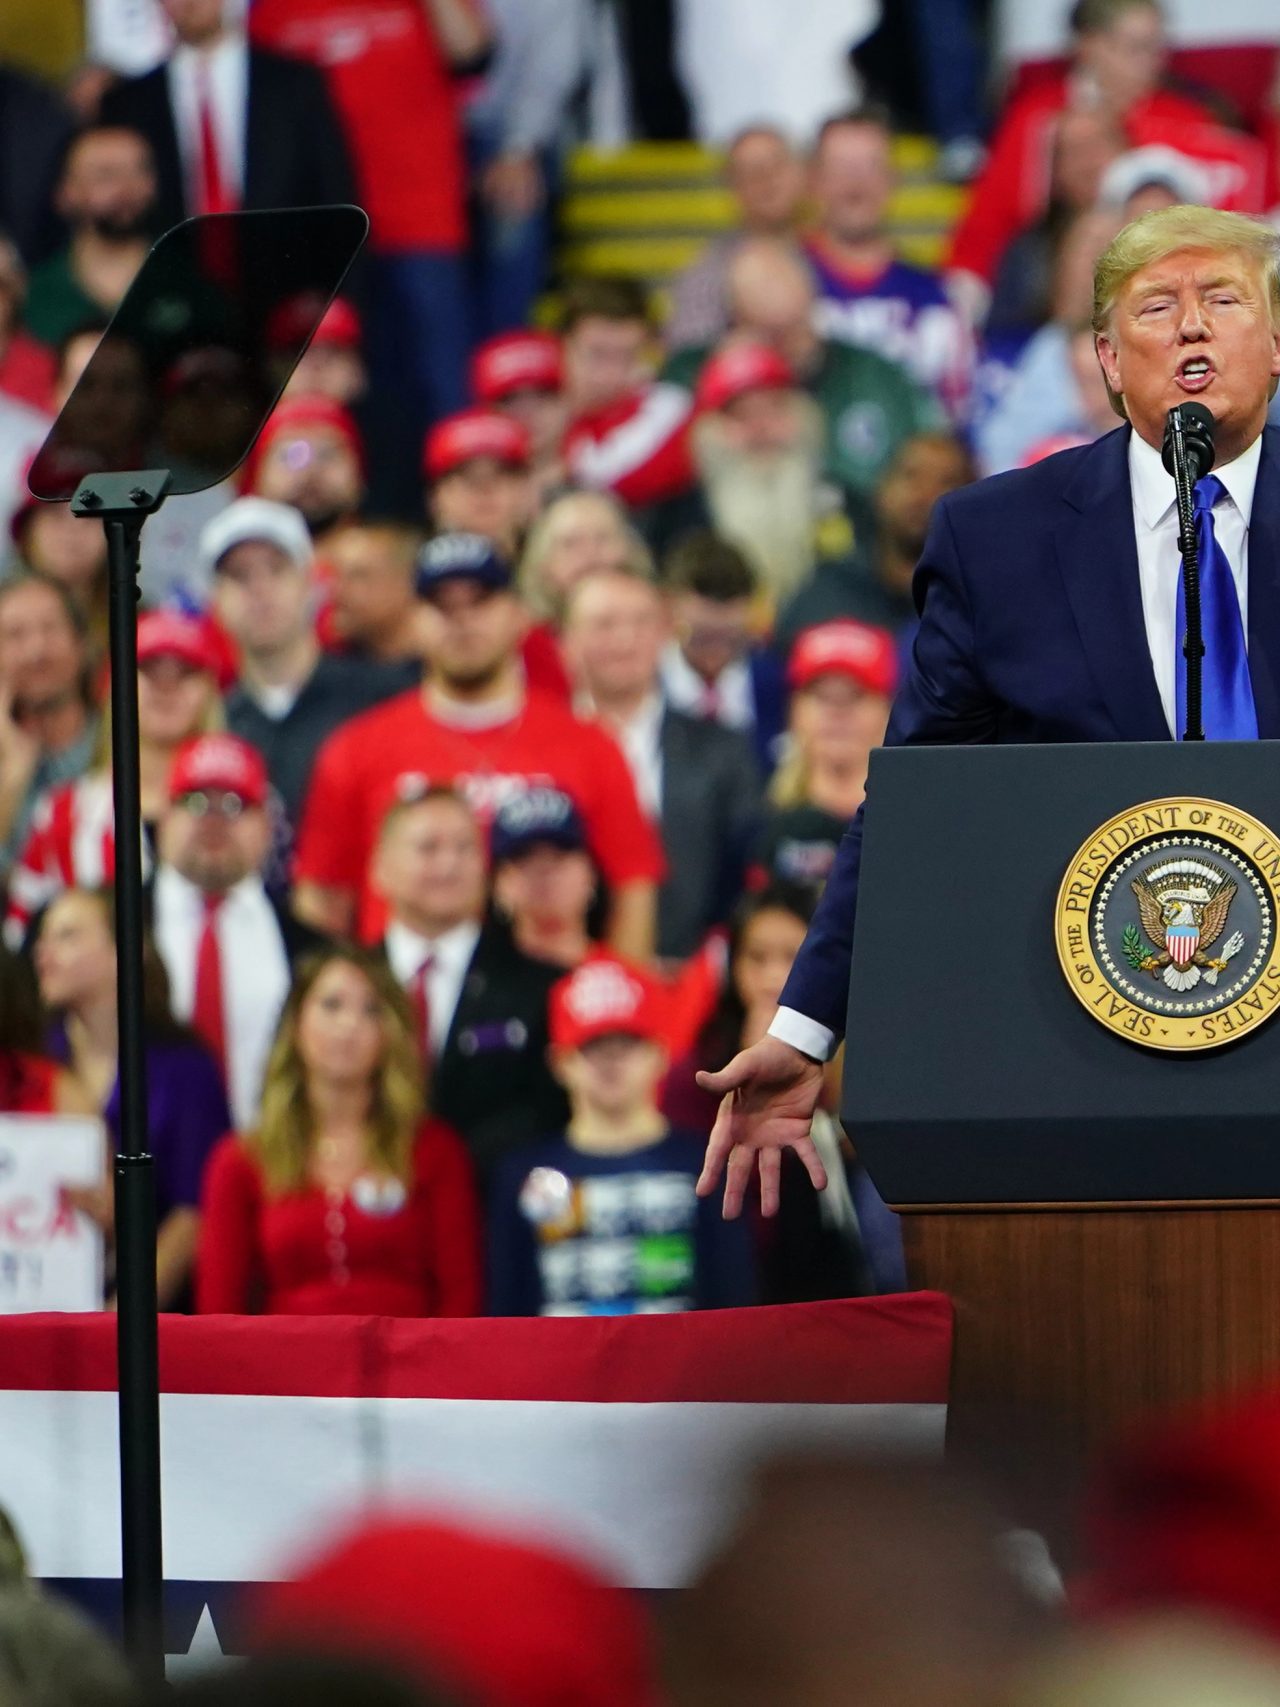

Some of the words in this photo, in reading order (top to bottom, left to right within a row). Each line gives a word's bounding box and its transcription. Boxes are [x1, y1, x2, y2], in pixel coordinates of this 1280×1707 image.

[1189, 810, 1213, 826] OF
[1217, 815, 1249, 841] THE
[1065, 807, 1182, 914] PRESIDENT
[1067, 923, 1085, 959] THE
[1075, 962, 1096, 985] OF
[1092, 983, 1156, 1037] SEAL
